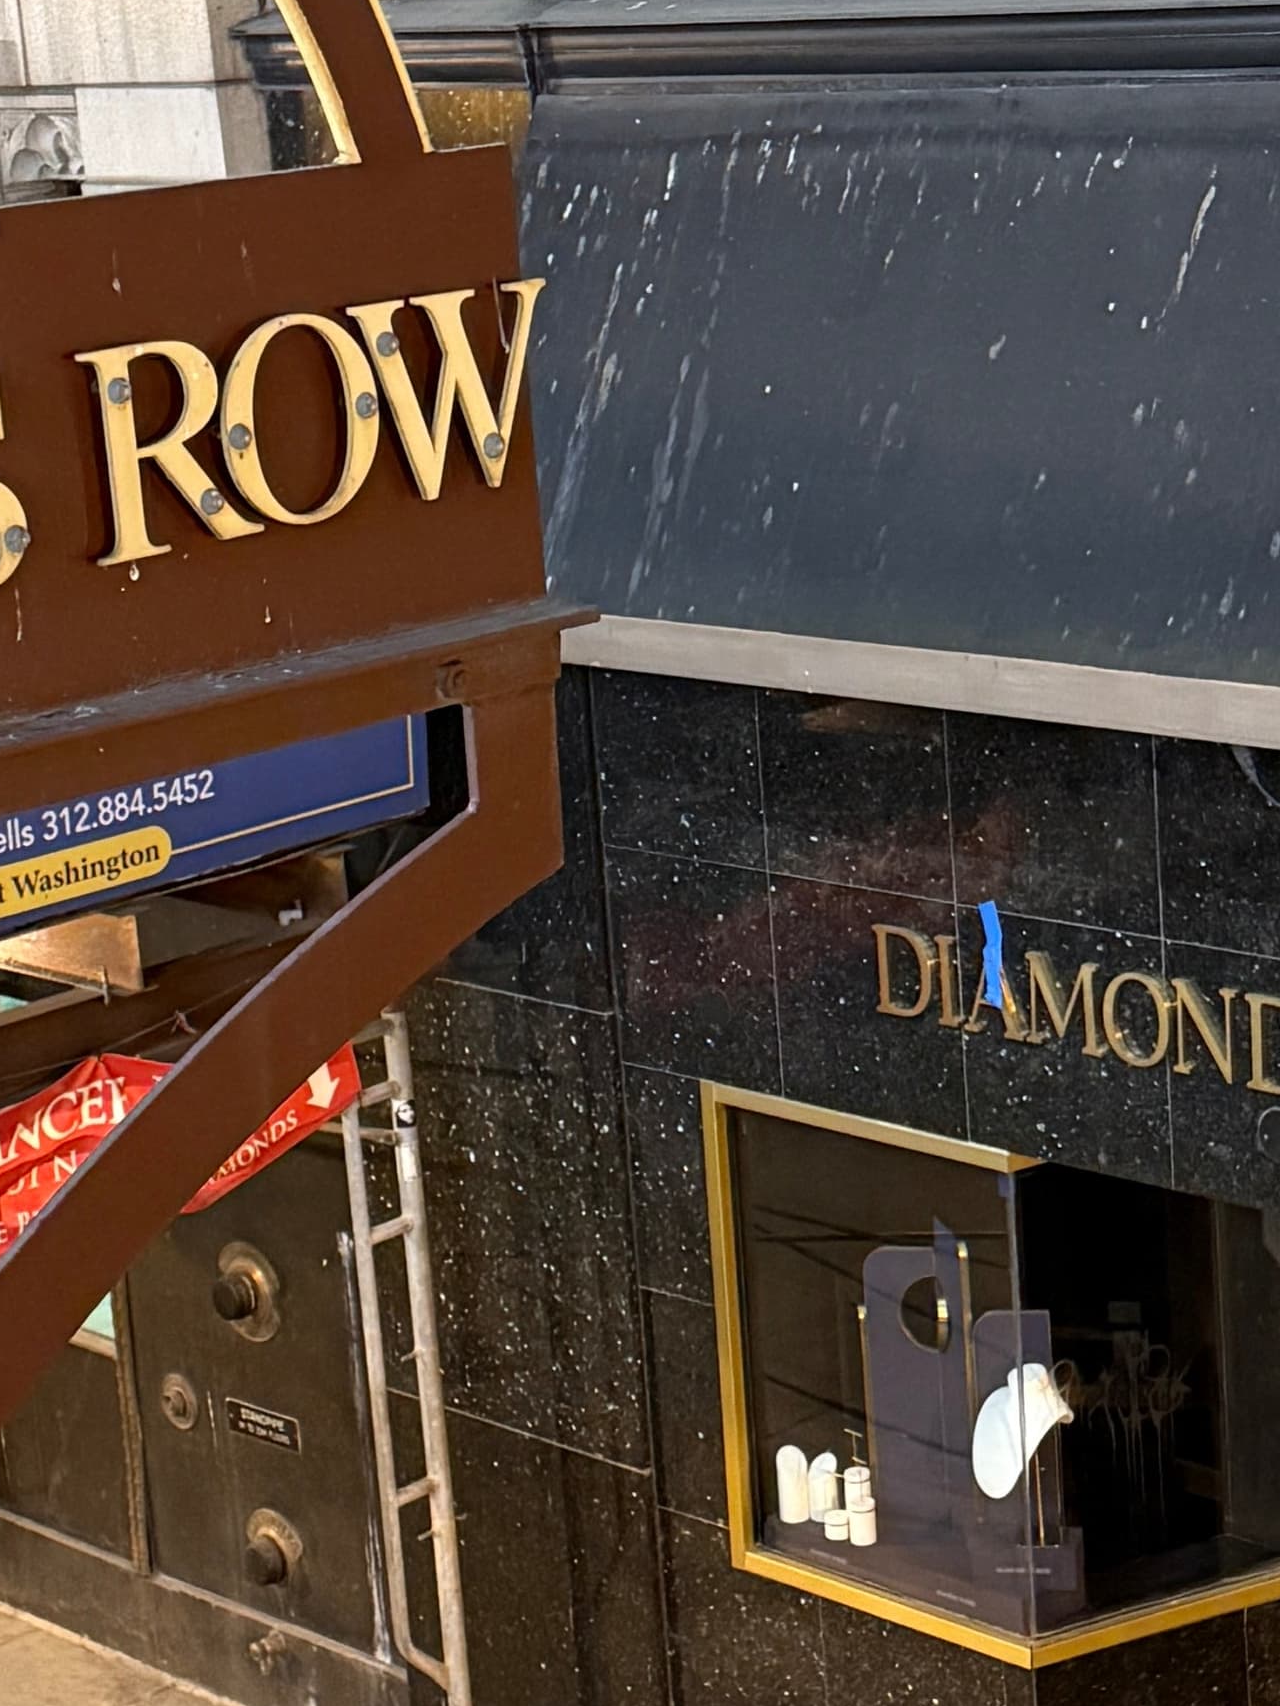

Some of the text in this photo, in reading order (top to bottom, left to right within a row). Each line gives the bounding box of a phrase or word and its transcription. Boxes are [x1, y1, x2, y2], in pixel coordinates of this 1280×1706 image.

[75, 277, 546, 567] ROW
[41, 768, 215, 841] 312.884.5452
[10, 841, 161, 895] Washington
